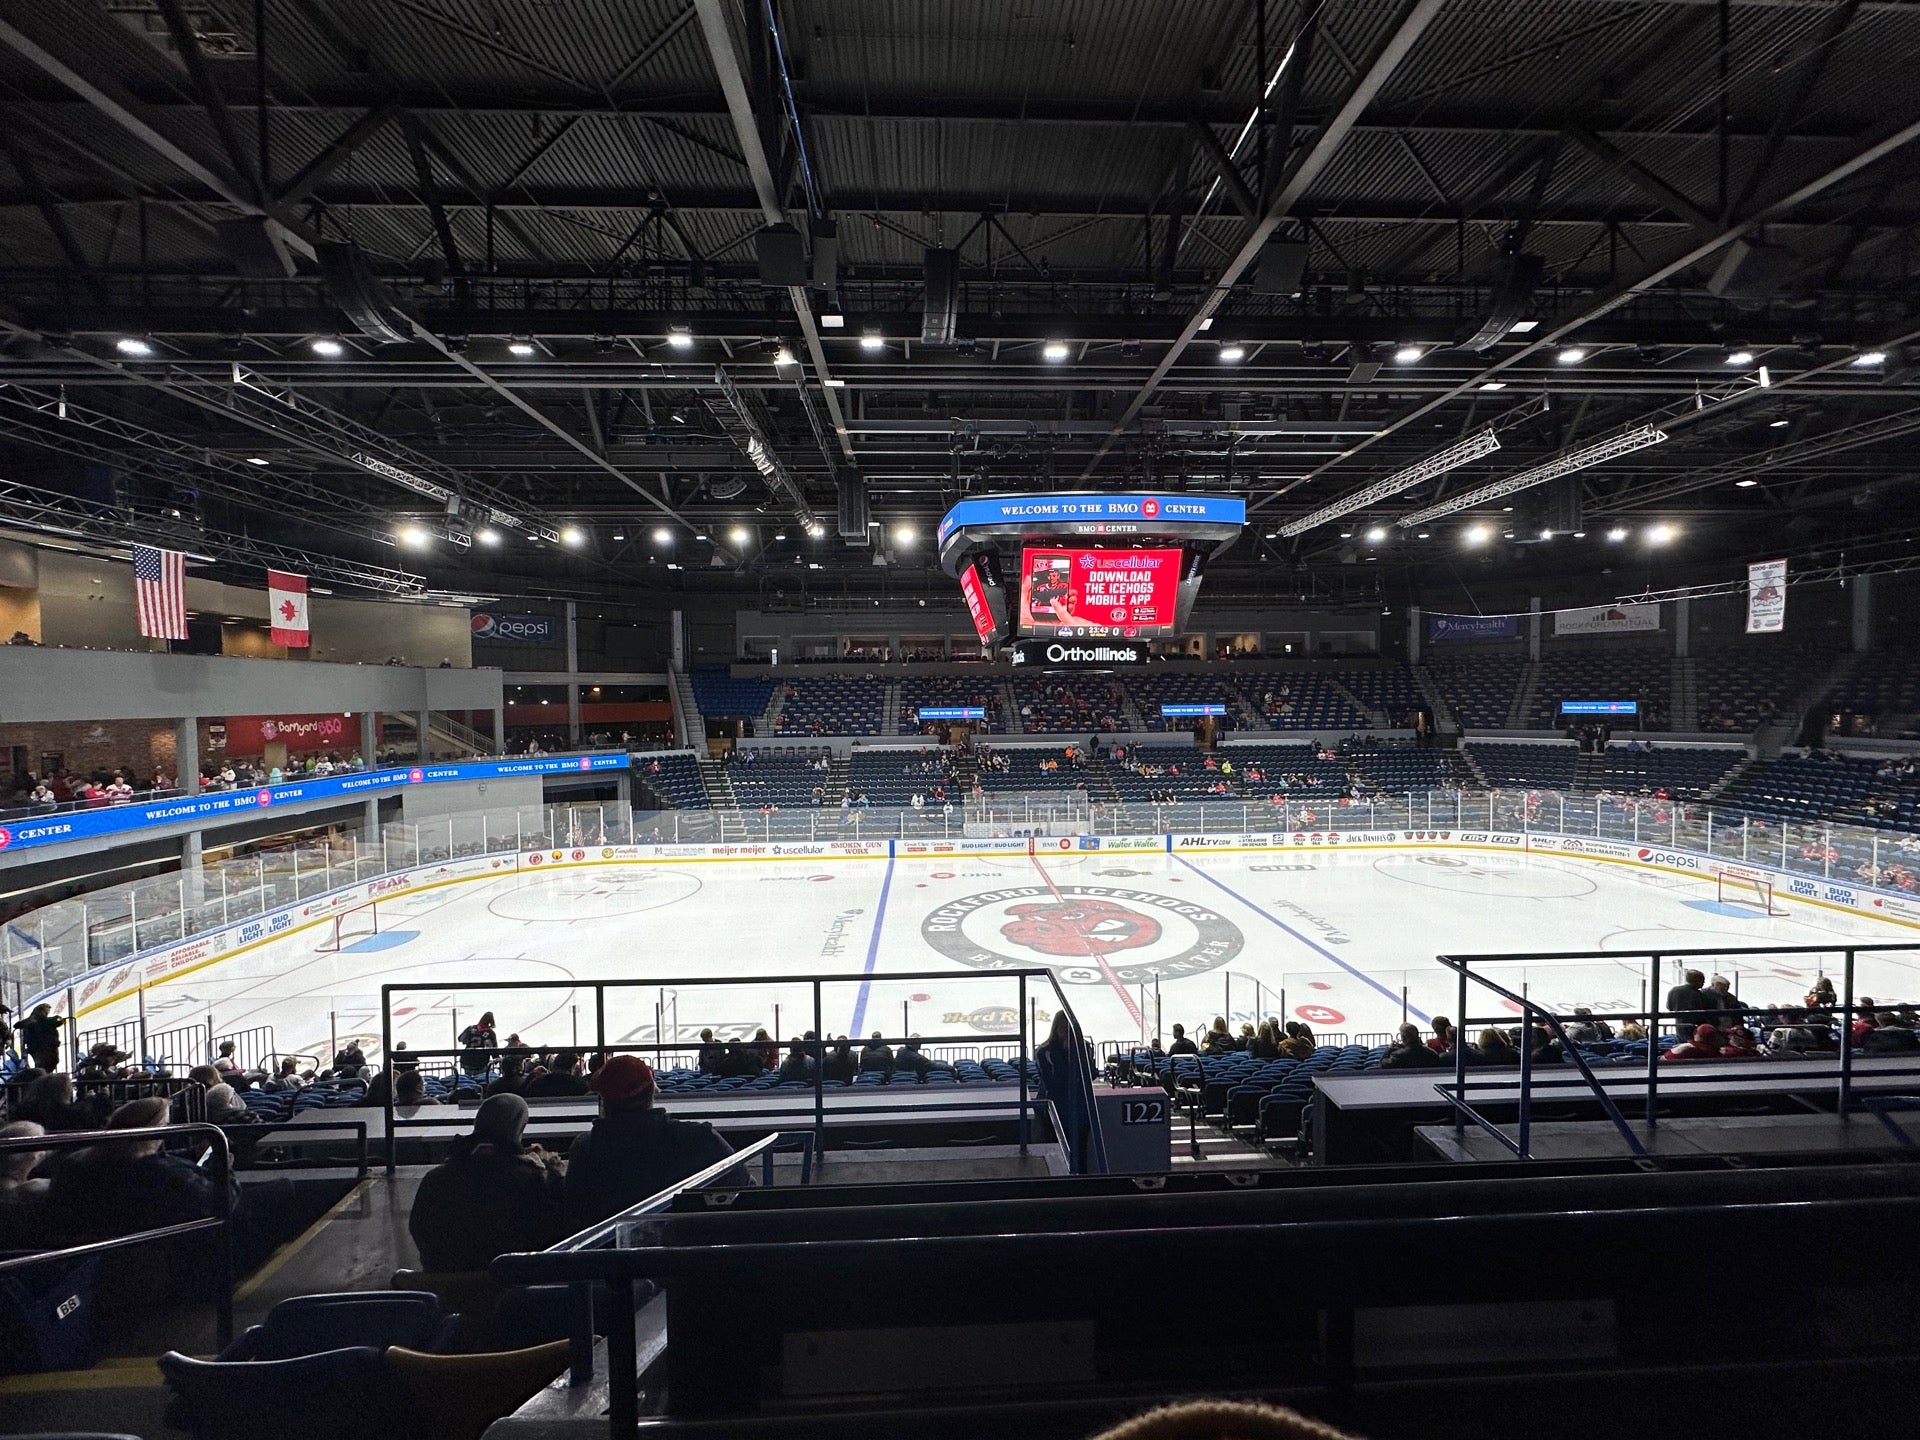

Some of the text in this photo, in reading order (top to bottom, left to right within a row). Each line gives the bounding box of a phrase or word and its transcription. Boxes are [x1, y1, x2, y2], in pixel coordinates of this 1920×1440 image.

[1002, 503, 1206, 515] WELCOME TO THE BMO CENTER
[1096, 556, 1163, 569] uscellular
[1089, 571, 1152, 582] DOWNLOAD
[1084, 582, 1154, 594] THE ICEHOGS
[1085, 594, 1151, 606] MOBILE APP
[500, 622, 548, 636] pepsi
[1447, 620, 1506, 633] Mercyhealth
[1559, 619, 1654, 630] ROCKFORD MUTUAL
[1077, 627, 1084, 636] 0
[1112, 627, 1119, 636] 0
[1046, 644, 1136, 662] OrthoIllinois
[278, 718, 342, 736] Barnyard BBQ
[342, 778, 371, 788] WELCOME
[393, 773, 407, 781] BMO
[428, 770, 458, 778] CENTER
[146, 789, 302, 820] WELCOME TO THE BMO CENTER
[18, 824, 72, 840] CENTER
[712, 846, 738, 855] meijer
[740, 846, 766, 854] meijer
[783, 845, 824, 855] uscellular
[1655, 852, 1699, 868] pepsi
[368, 874, 410, 894] PEAK
[1794, 879, 1814, 890] BUD
[1789, 886, 1819, 897] LIGHT
[1829, 887, 1852, 898] BUD
[1825, 892, 1856, 905] LIGHT
[928, 886, 1218, 933] ROCKFORD ICEHOGS
[272, 913, 289, 925] BUD
[242, 923, 261, 935] BUD
[269, 919, 292, 933] LIGHT
[239, 930, 265, 944] LIGHT
[170, 939, 211, 957] AFFORDABLE.
[170, 949, 200, 963] RELIABLE.
[171, 952, 207, 968] CHILDCARE.
[968, 940, 1230, 980] BM CENTER
[942, 1010, 1052, 1023] Hard Rk
[1124, 1102, 1163, 1123] 122
